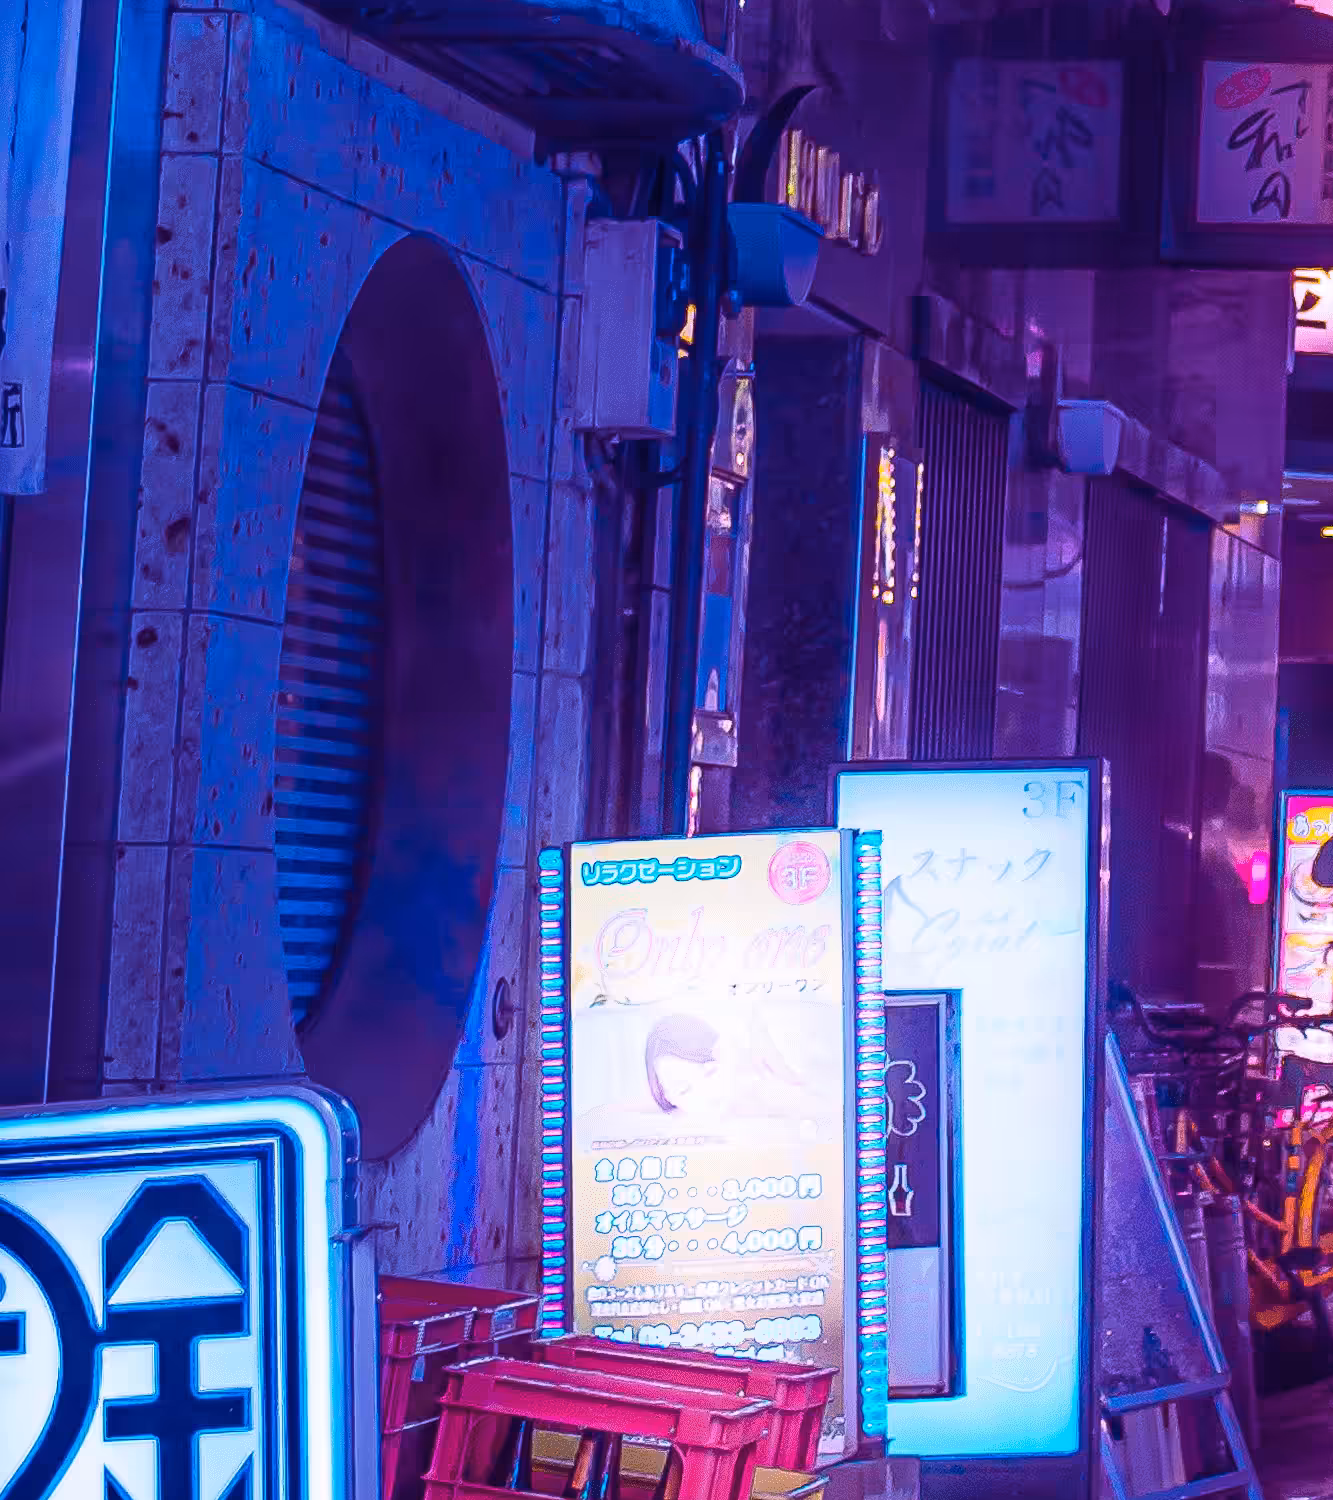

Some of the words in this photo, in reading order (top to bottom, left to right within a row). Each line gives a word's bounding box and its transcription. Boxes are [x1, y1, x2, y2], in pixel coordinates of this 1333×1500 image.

[1022, 779, 1086, 819] 3F
[581, 854, 743, 887] リラクゼーション
